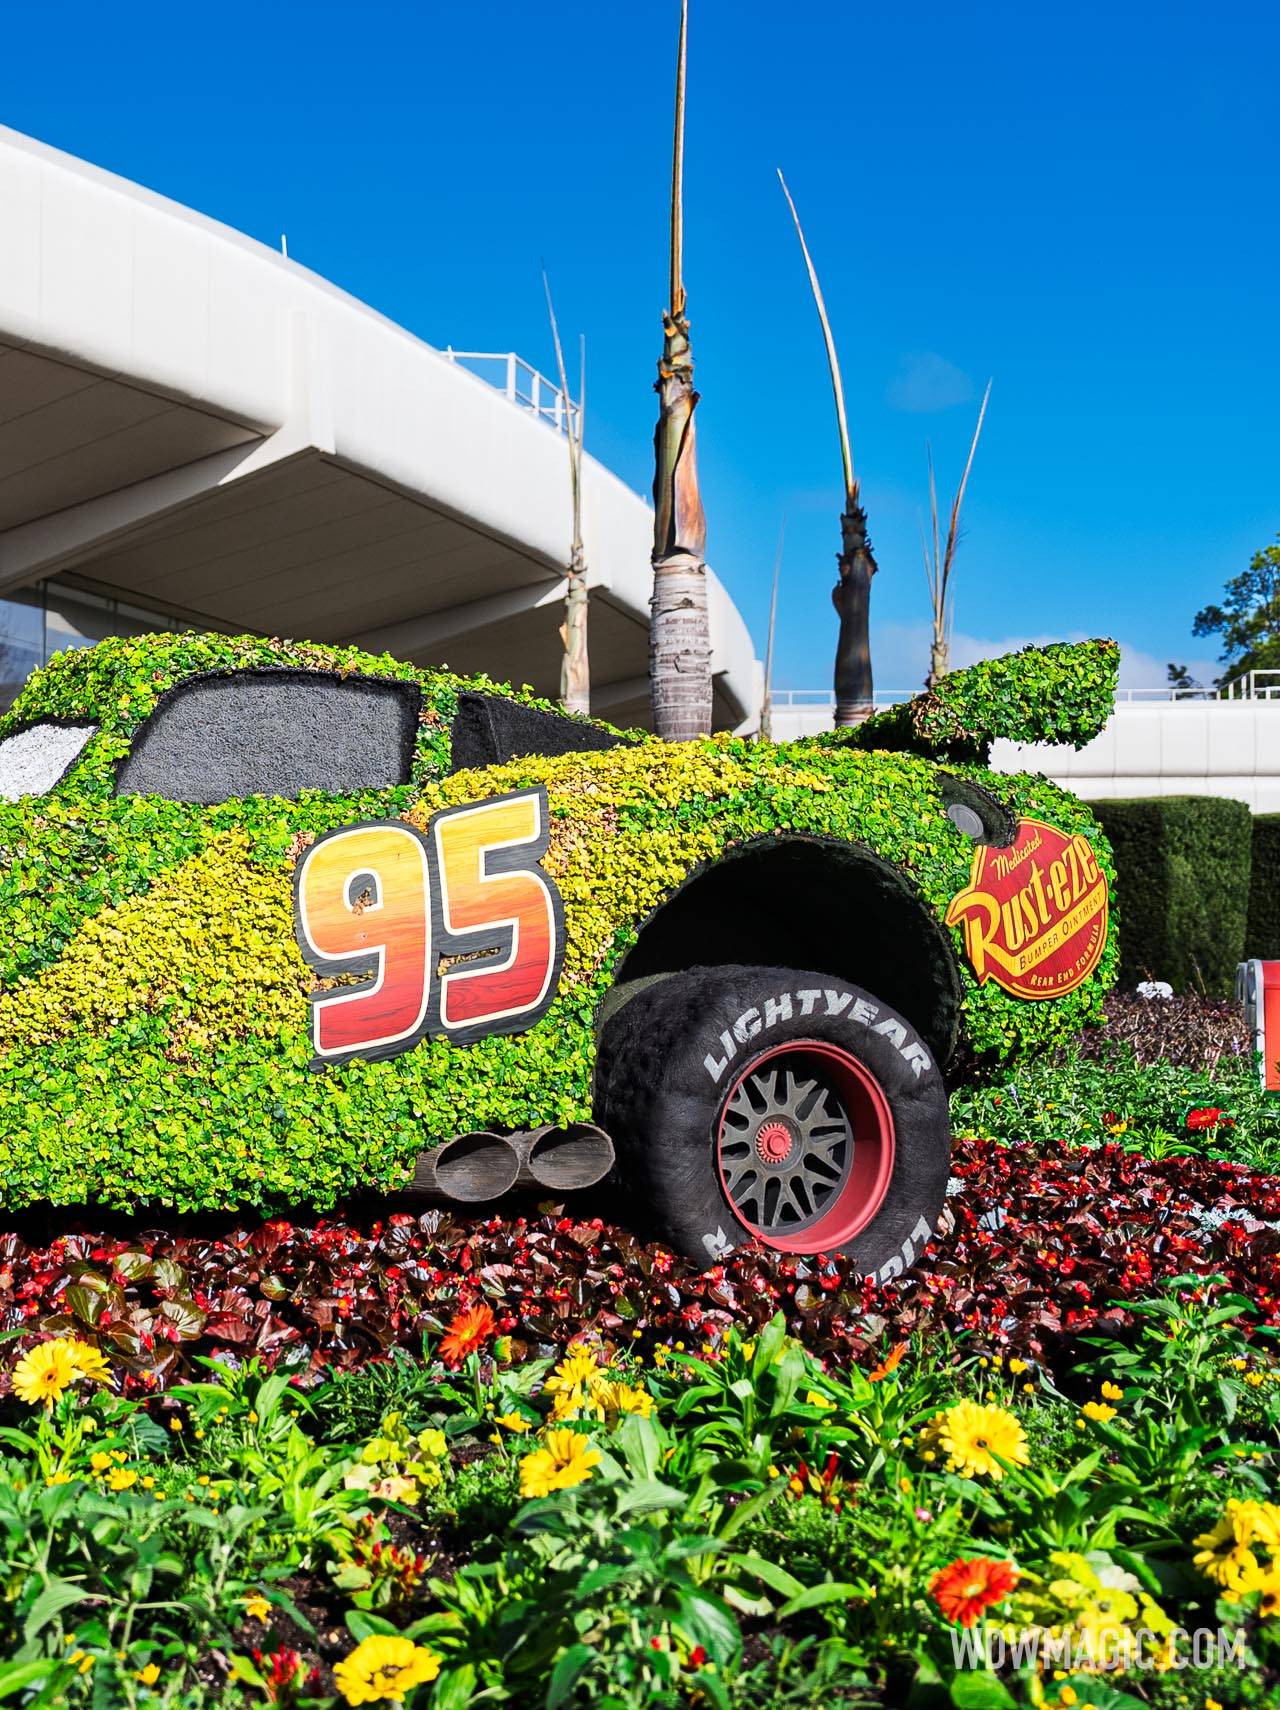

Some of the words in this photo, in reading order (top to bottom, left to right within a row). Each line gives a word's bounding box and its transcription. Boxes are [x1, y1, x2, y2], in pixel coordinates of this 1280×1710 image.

[990, 828, 1042, 880] Medicated
[296, 790, 560, 1060] 95
[1020, 933, 1059, 970] BUMPER
[1031, 974, 1054, 986] REAR
[1057, 968, 1074, 983] END
[1076, 924, 1099, 970] FORMULA
[703, 989, 933, 1084] LIGHTYEAR
